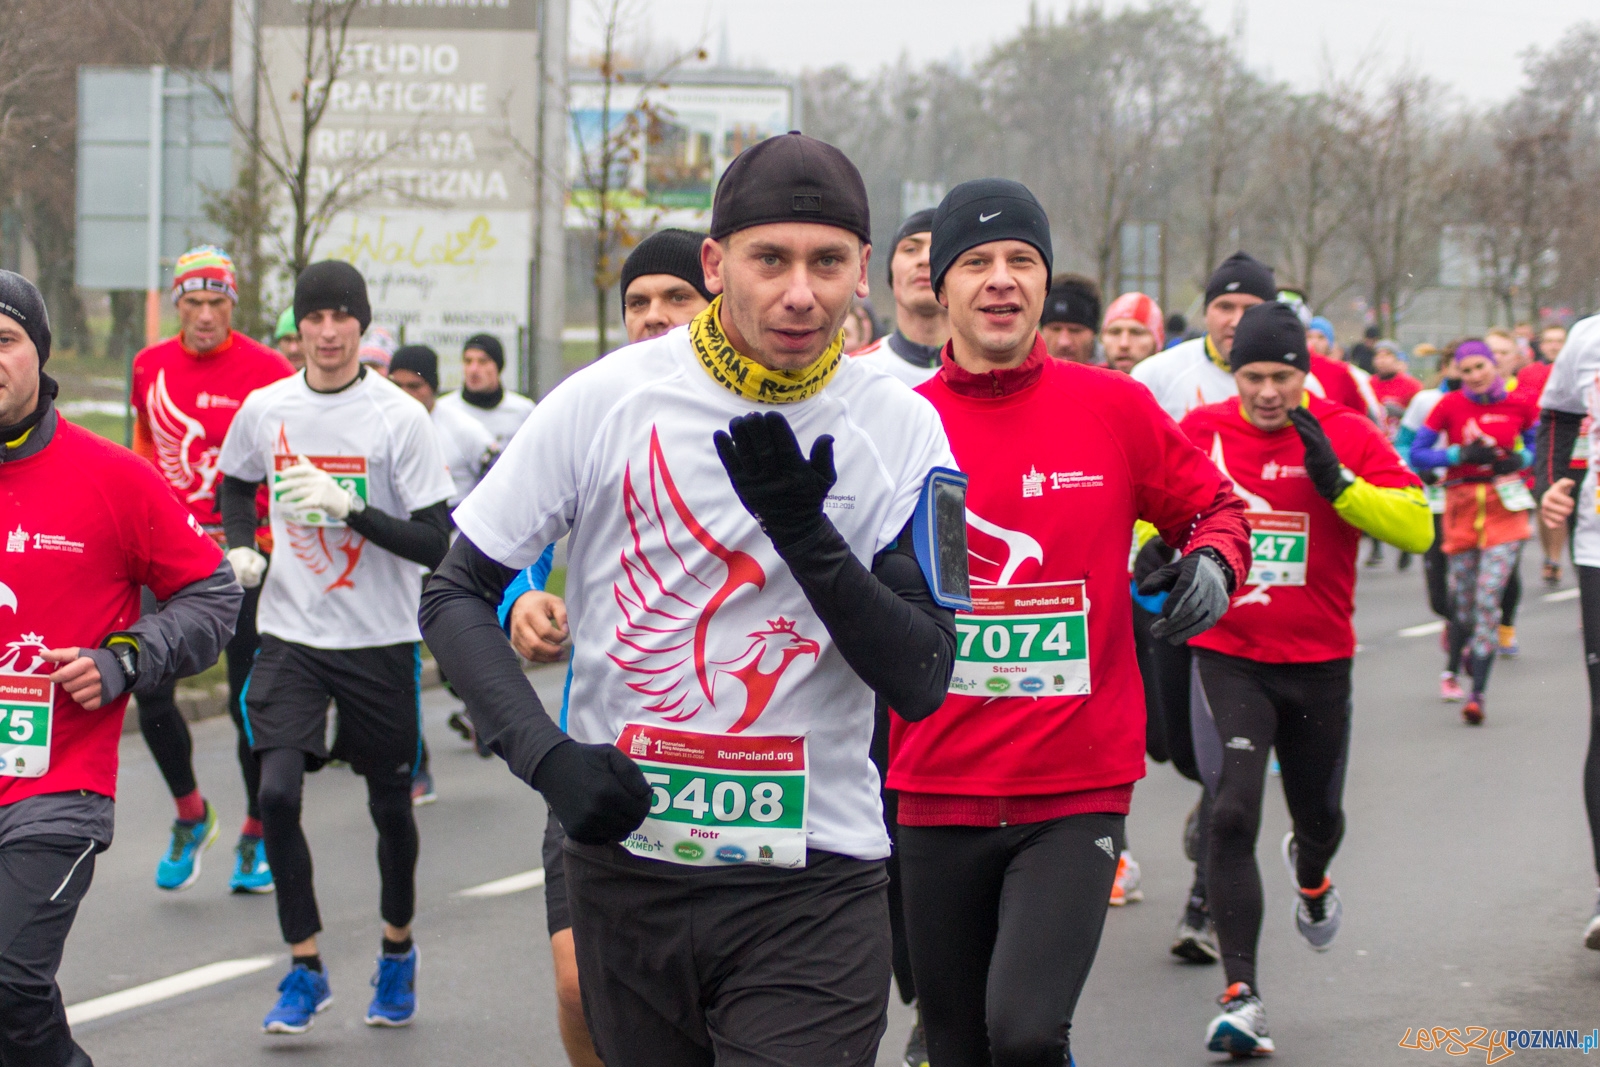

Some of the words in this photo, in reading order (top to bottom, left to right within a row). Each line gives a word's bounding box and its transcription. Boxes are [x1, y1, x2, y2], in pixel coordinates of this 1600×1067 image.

[339, 43, 460, 75] STUDIO
[307, 80, 488, 114] GRAFICZNE
[314, 128, 477, 161] REKLAMA
[1014, 596, 1075, 607] RunPoland.org
[956, 621, 1071, 659] 7074
[992, 665, 1028, 674] Stachu
[717, 750, 794, 762] RunPoland.org
[643, 771, 785, 823] 5408
[690, 828, 720, 839] Piotr
